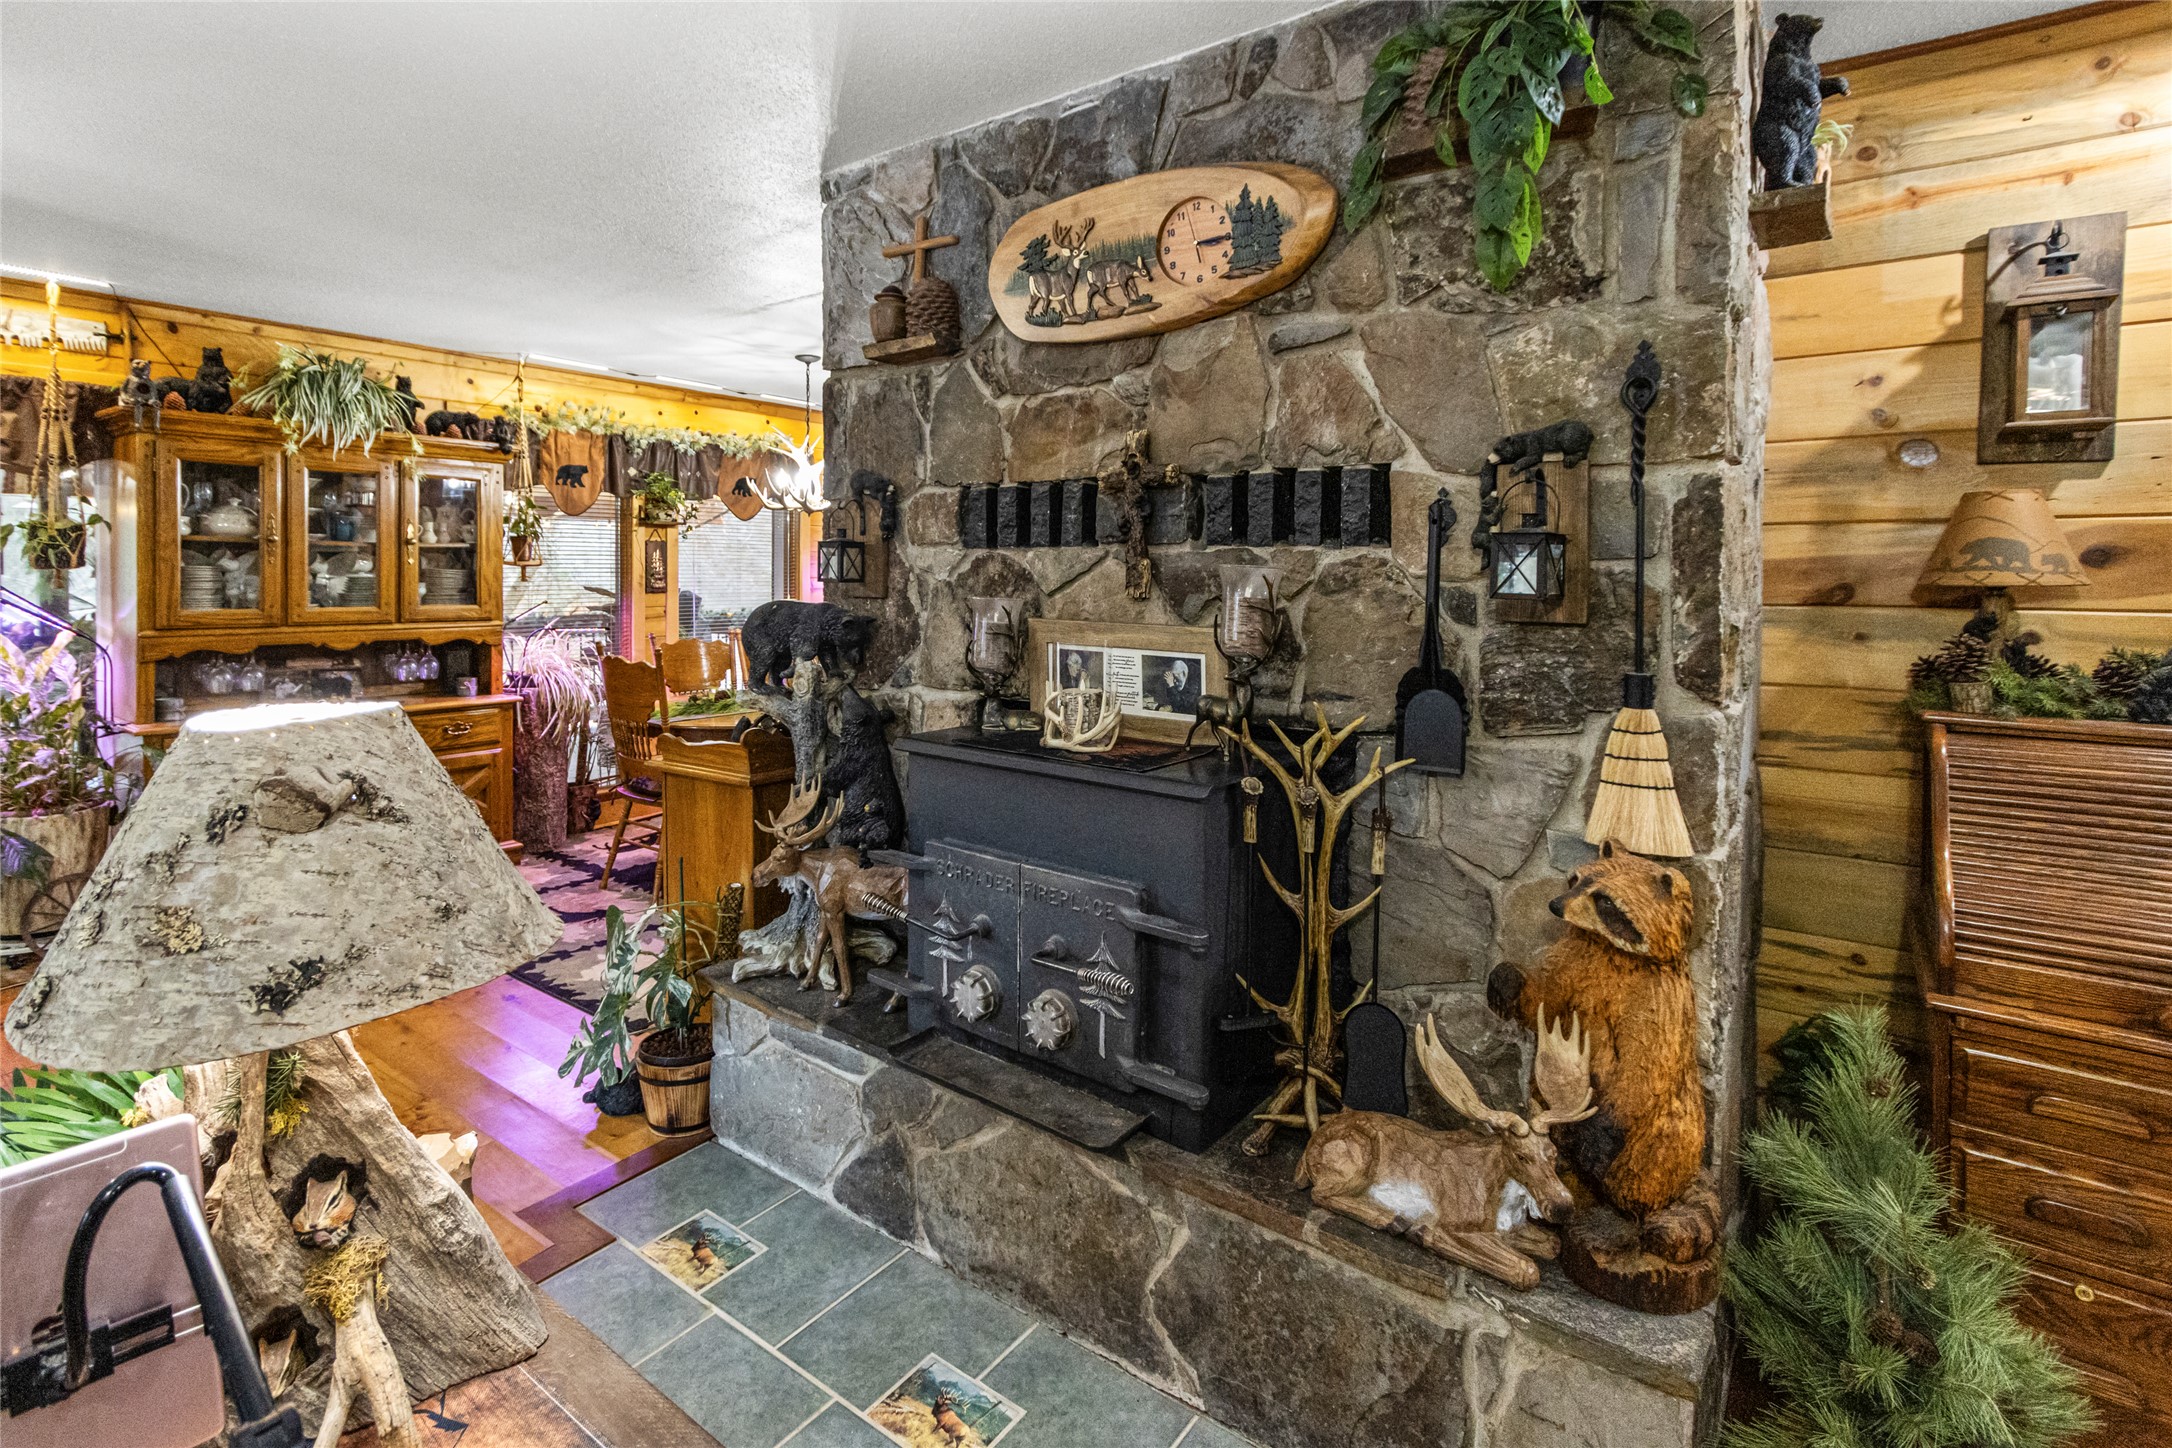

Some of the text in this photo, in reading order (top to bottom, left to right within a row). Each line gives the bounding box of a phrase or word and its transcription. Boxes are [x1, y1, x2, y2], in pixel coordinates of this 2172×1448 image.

[1193, 201, 1201, 211] 12
[1211, 205, 1215, 213] 1
[1177, 212, 1185, 221] 11
[1219, 216, 1226, 224] 2
[1167, 228, 1175, 237] 10
[1164, 246, 1170, 255] 9
[1222, 250, 1229, 259] 4
[1170, 261, 1176, 269] 8
[1211, 265, 1218, 274] 5
[1180, 272, 1186, 280] 7
[1197, 275, 1203, 283] 6
[936, 859, 1116, 921] SCHRADER FIREPLACE
